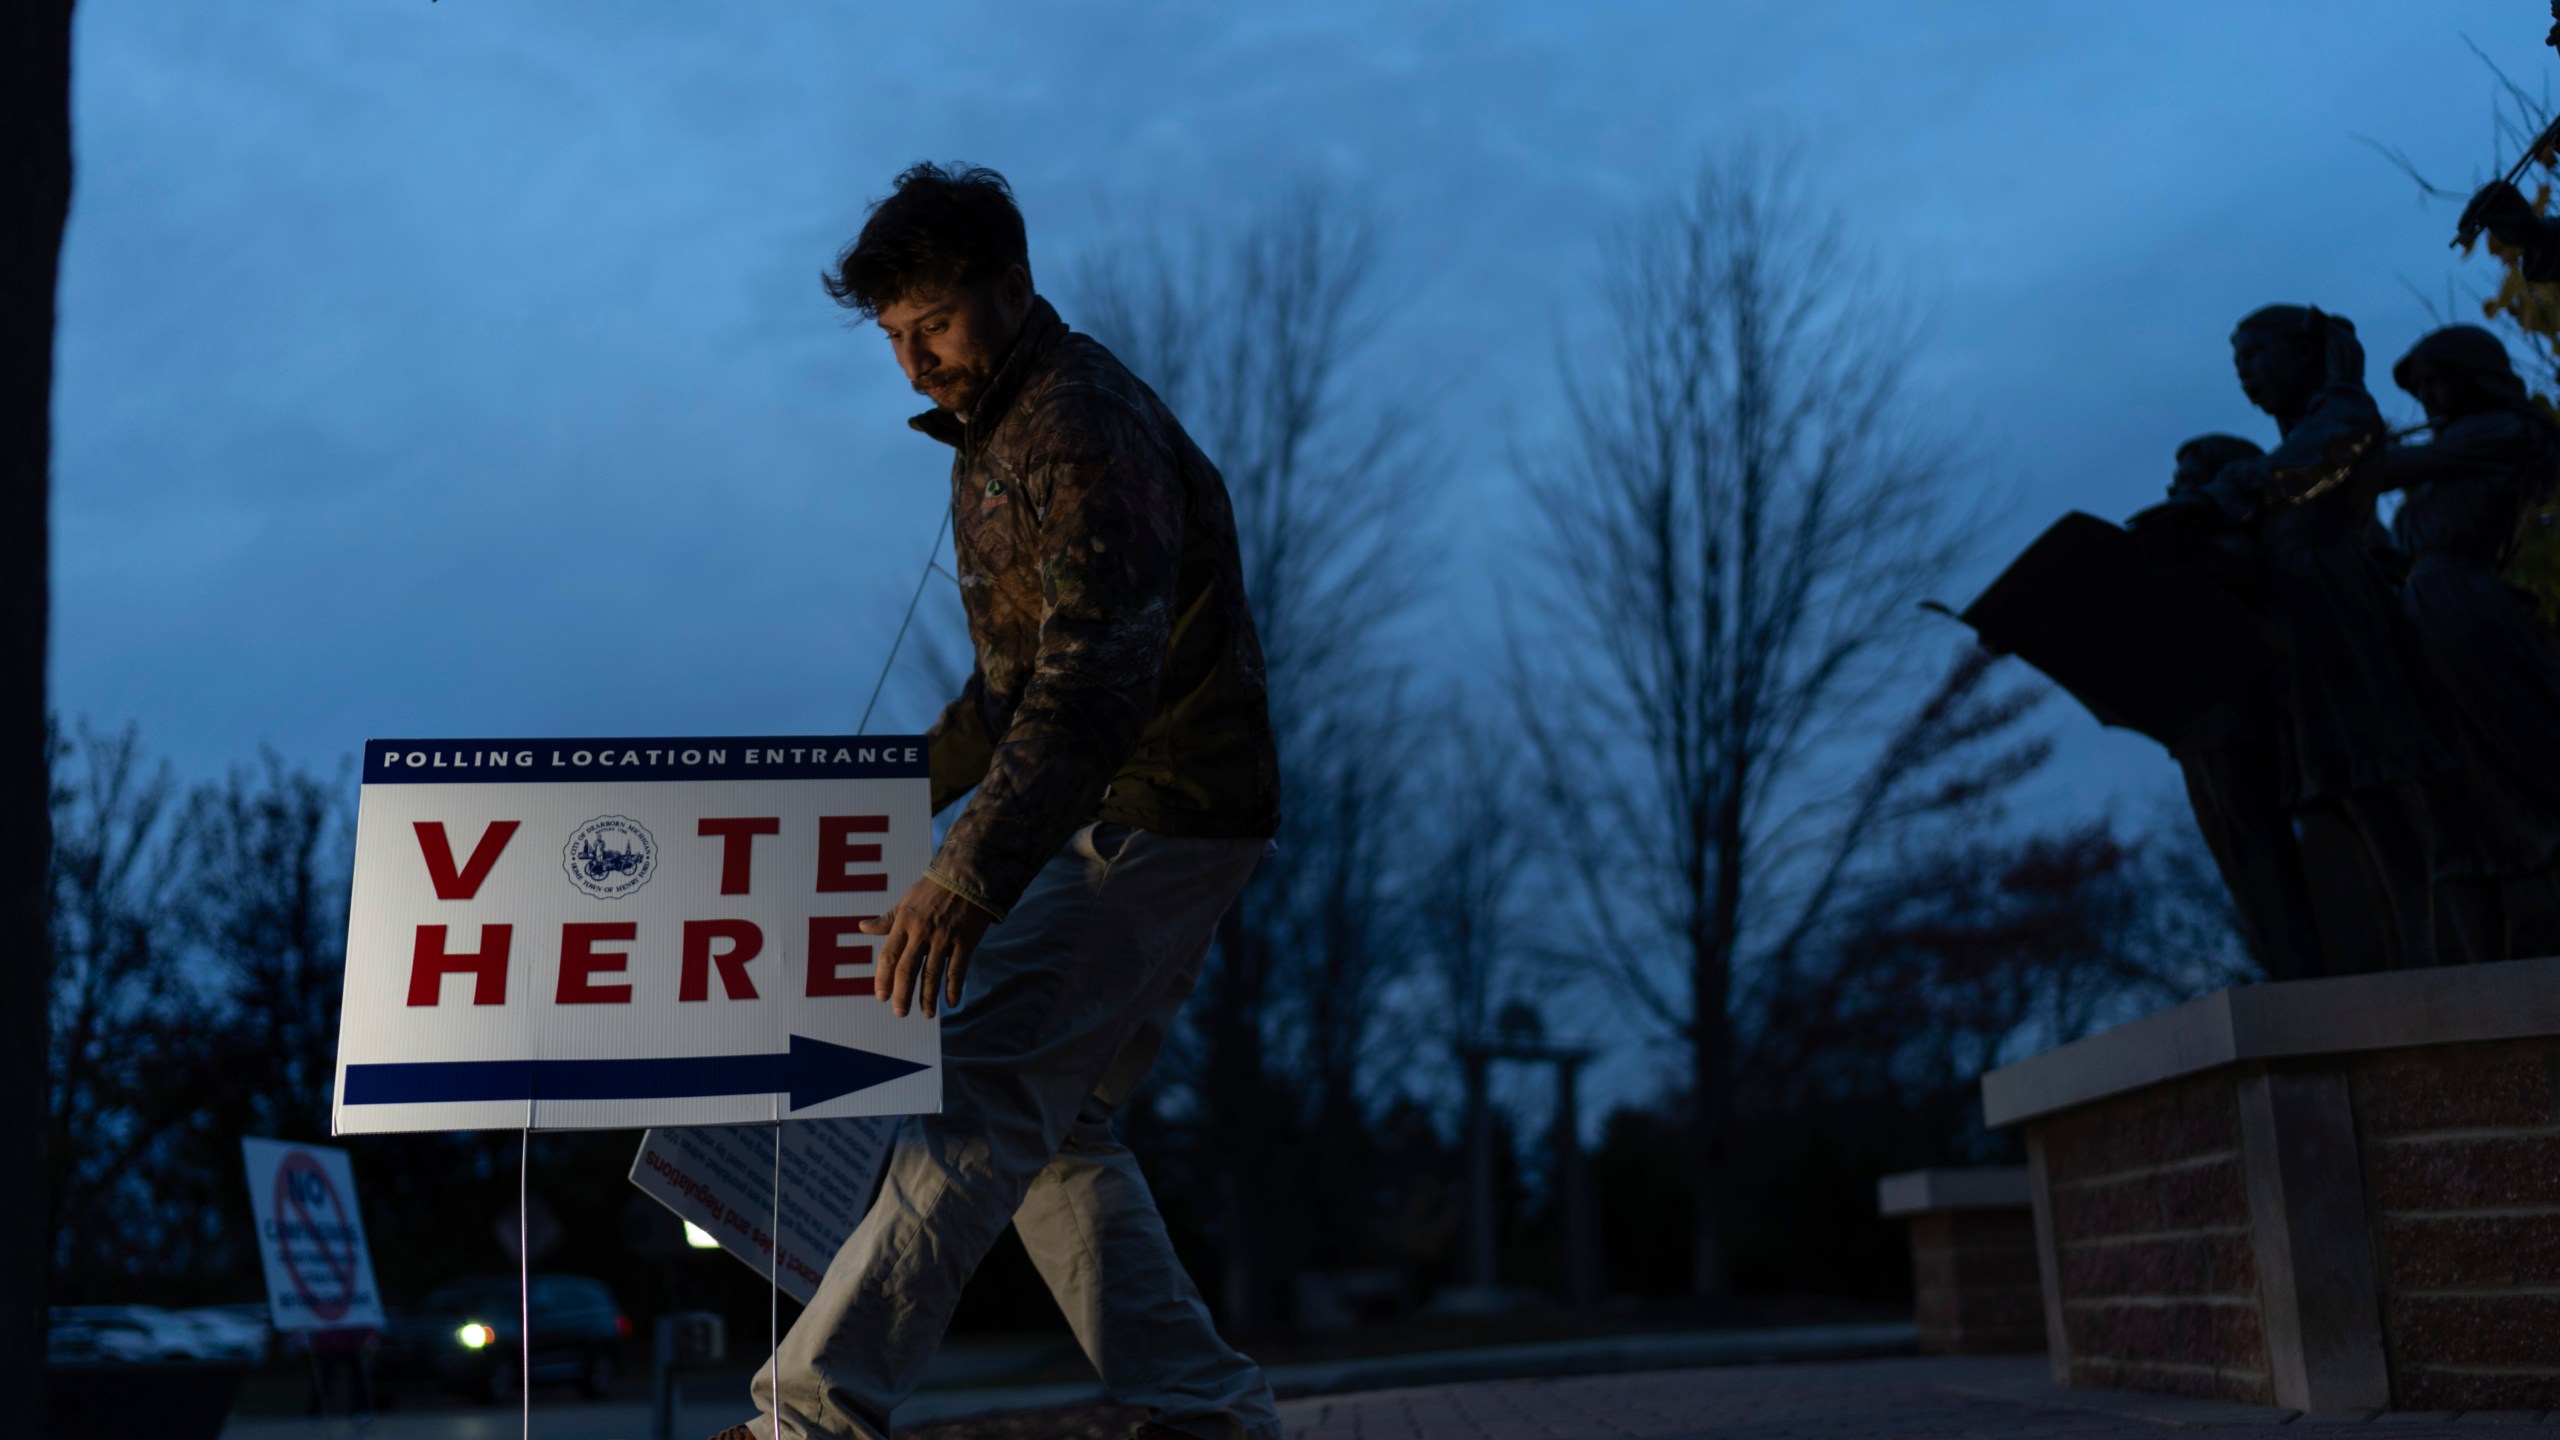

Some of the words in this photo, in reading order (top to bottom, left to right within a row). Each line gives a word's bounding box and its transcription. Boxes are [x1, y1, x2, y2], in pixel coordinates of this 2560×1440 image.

[383, 751, 533, 768] POLLING
[552, 749, 727, 766] LOCATION
[745, 747, 919, 765] ENTRANCE
[571, 841, 580, 855] CITY
[578, 832, 586, 842] OF
[586, 820, 626, 834] DEARBORN
[627, 824, 652, 855] MICHIGAN
[571, 862, 583, 881] HOME
[583, 880, 602, 892] TOWN
[604, 885, 613, 893] OF
[616, 877, 640, 893] HENRY
[639, 861, 650, 879] FORD
[406, 915, 880, 1006] HERE
[662, 1126, 679, 1144] 100
[287, 1169, 325, 1208] NO
[645, 1150, 721, 1219] Regulations
[723, 1209, 750, 1234] and
